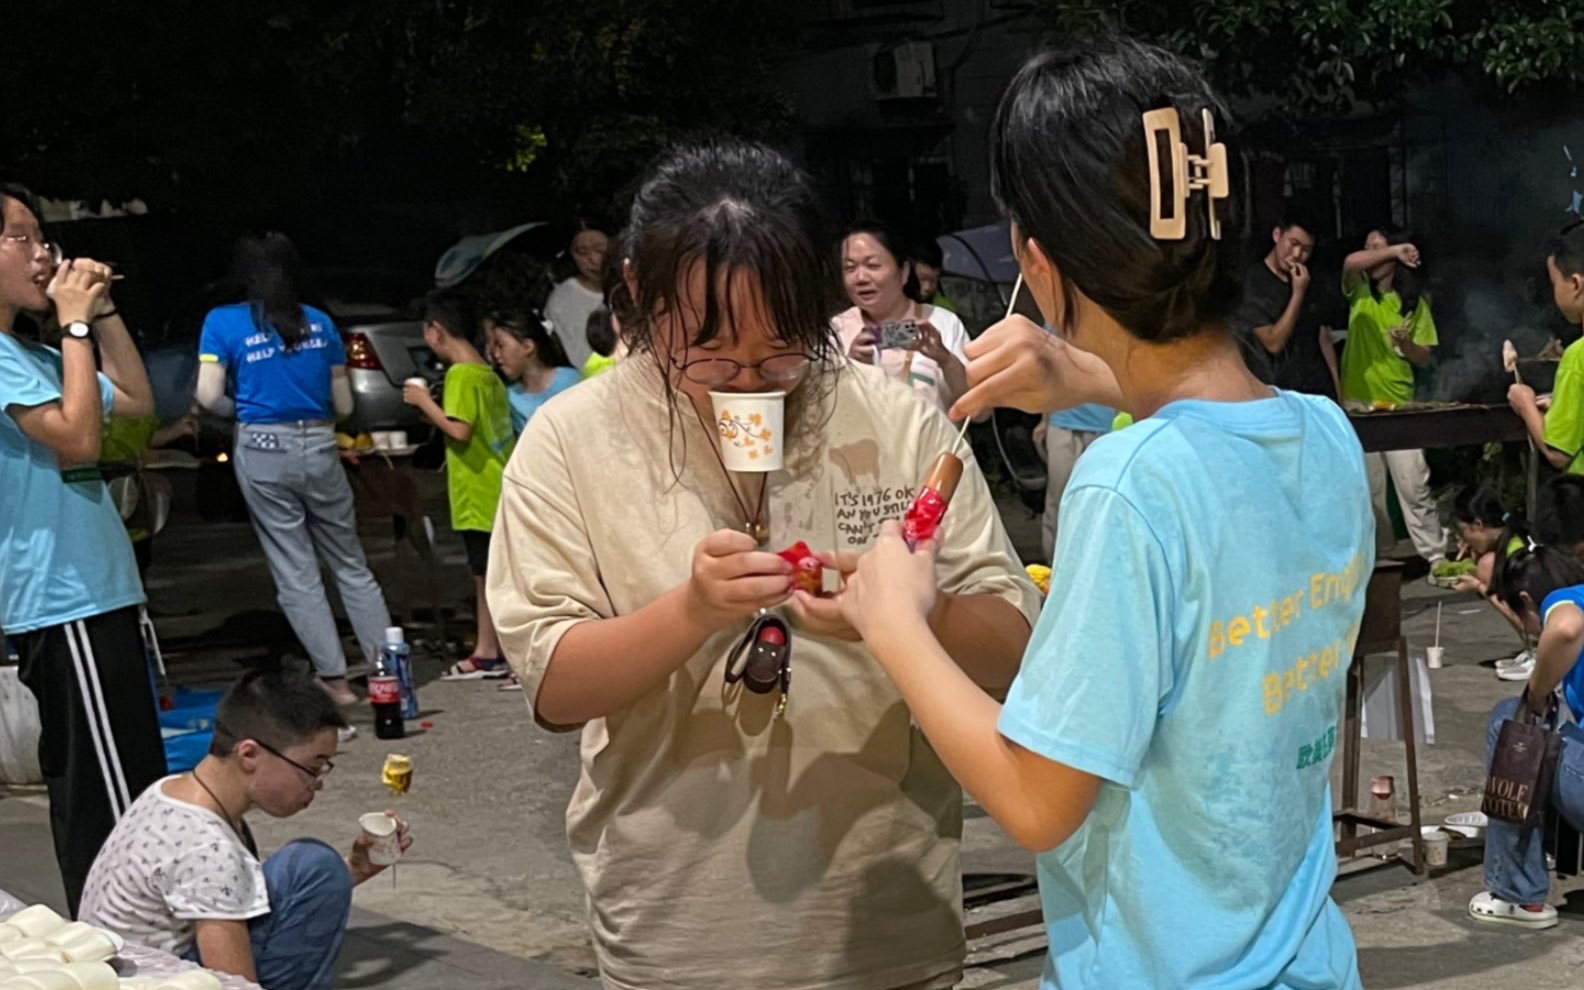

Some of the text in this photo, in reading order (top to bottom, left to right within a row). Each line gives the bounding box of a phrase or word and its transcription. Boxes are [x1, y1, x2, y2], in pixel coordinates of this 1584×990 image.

[862, 487, 891, 506] 1976
[895, 485, 915, 499] OK
[1207, 588, 1304, 660] Better
[1262, 638, 1341, 717] Better
